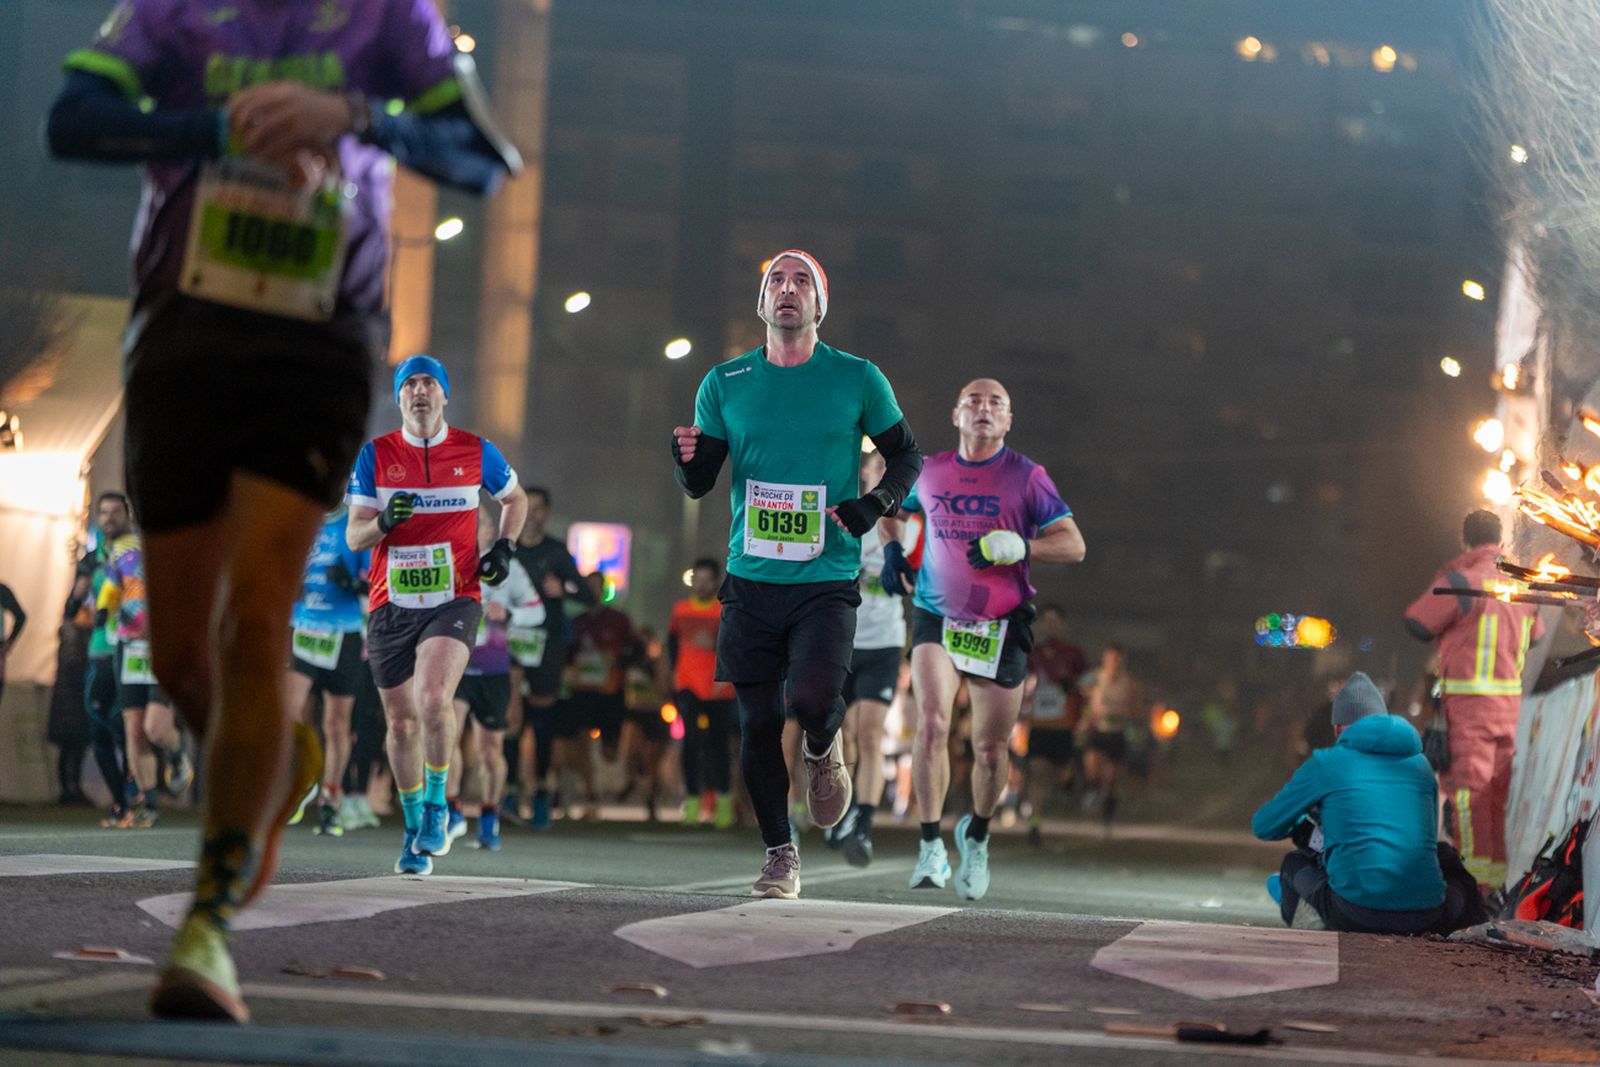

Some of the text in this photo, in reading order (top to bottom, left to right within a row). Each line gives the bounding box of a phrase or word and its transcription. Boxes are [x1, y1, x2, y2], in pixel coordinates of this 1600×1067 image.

[414, 496, 467, 507] Avanza
[753, 498, 766, 508] SAN
[760, 491, 794, 501] NOCHE DE
[758, 509, 808, 535] 6139
[399, 567, 441, 587] 4687
[951, 630, 992, 656] 5999
